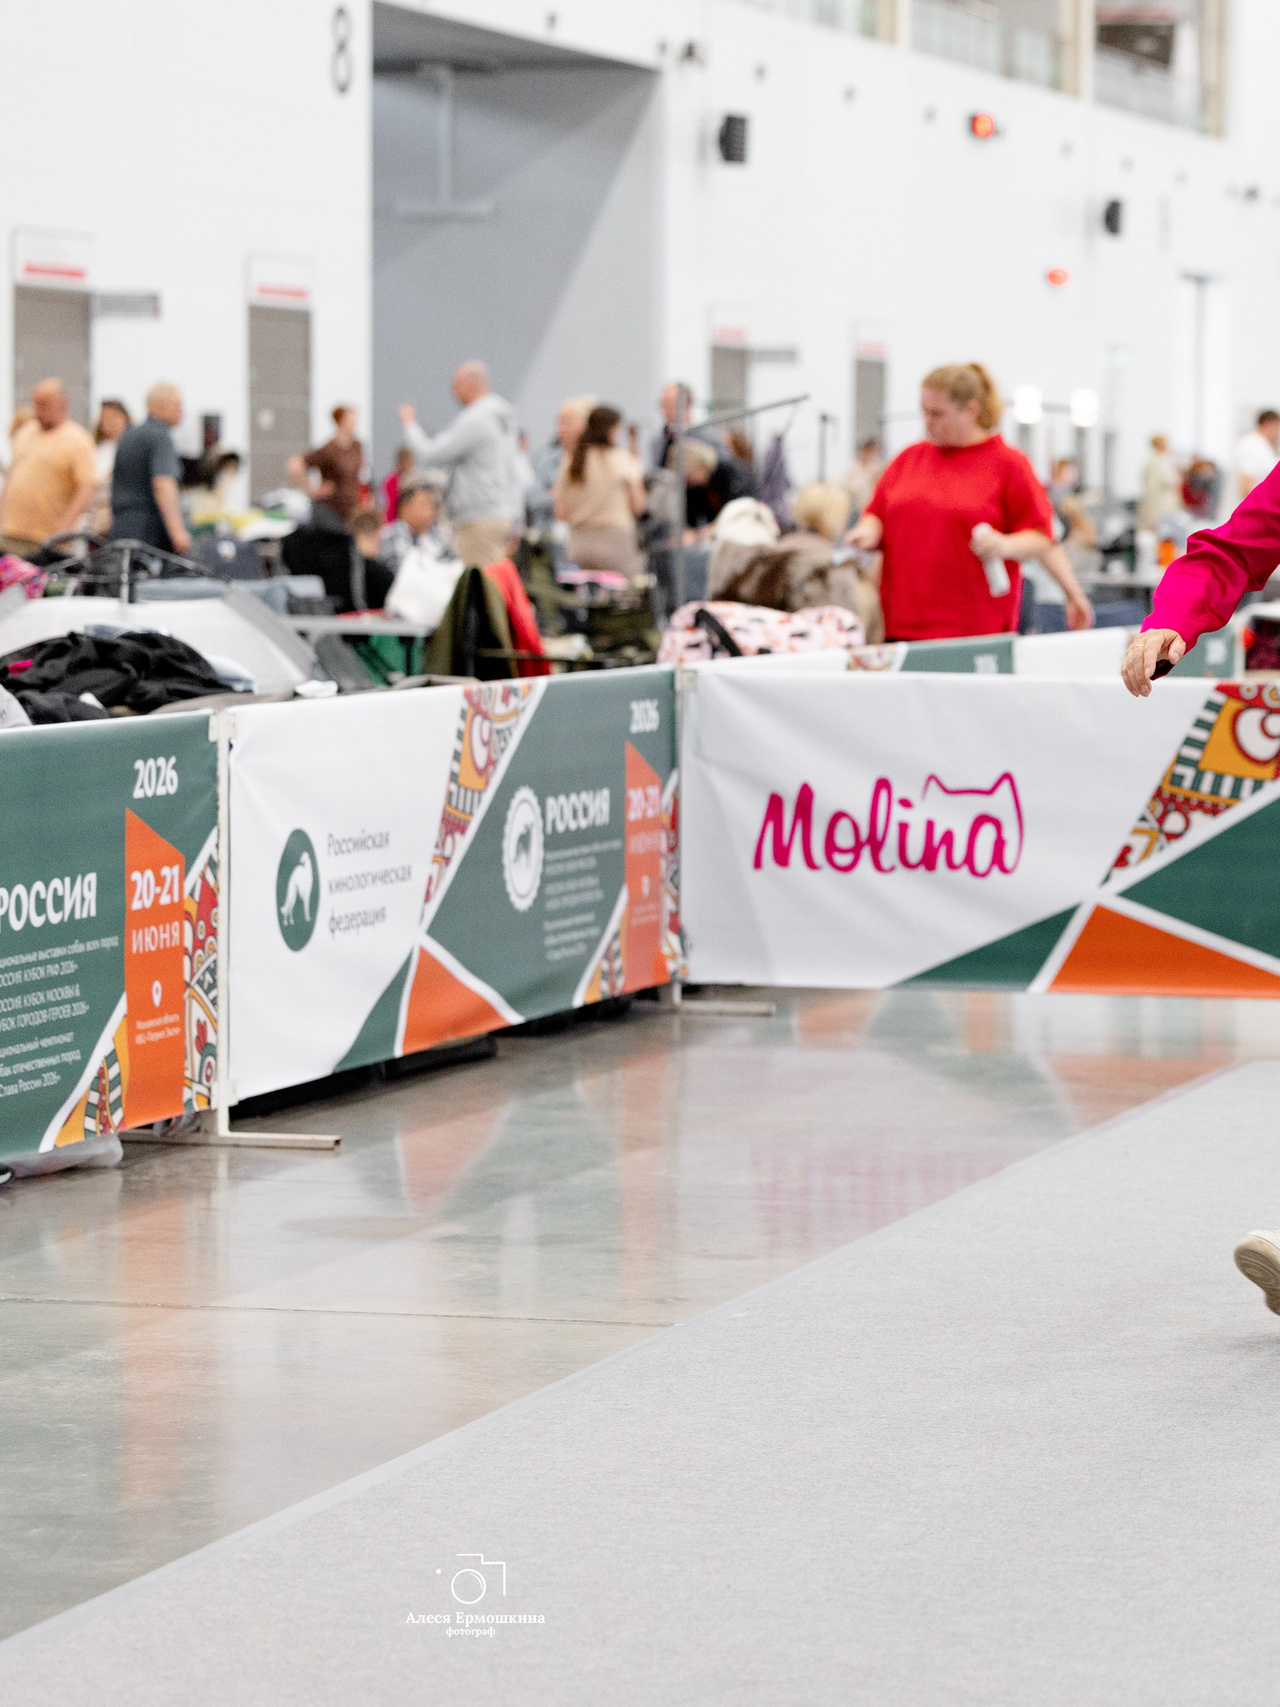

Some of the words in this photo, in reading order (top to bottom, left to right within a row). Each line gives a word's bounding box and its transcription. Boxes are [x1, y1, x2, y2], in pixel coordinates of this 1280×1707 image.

[133, 755, 178, 799] 2026
[546, 787, 610, 834] РОССИЯ
[753, 773, 1022, 878] Molina
[328, 829, 389, 857] Российская
[130, 864, 180, 911] 20-21
[328, 865, 412, 895] кинологическая
[131, 920, 180, 954] ИЮНЯ
[329, 906, 386, 941] федерация
